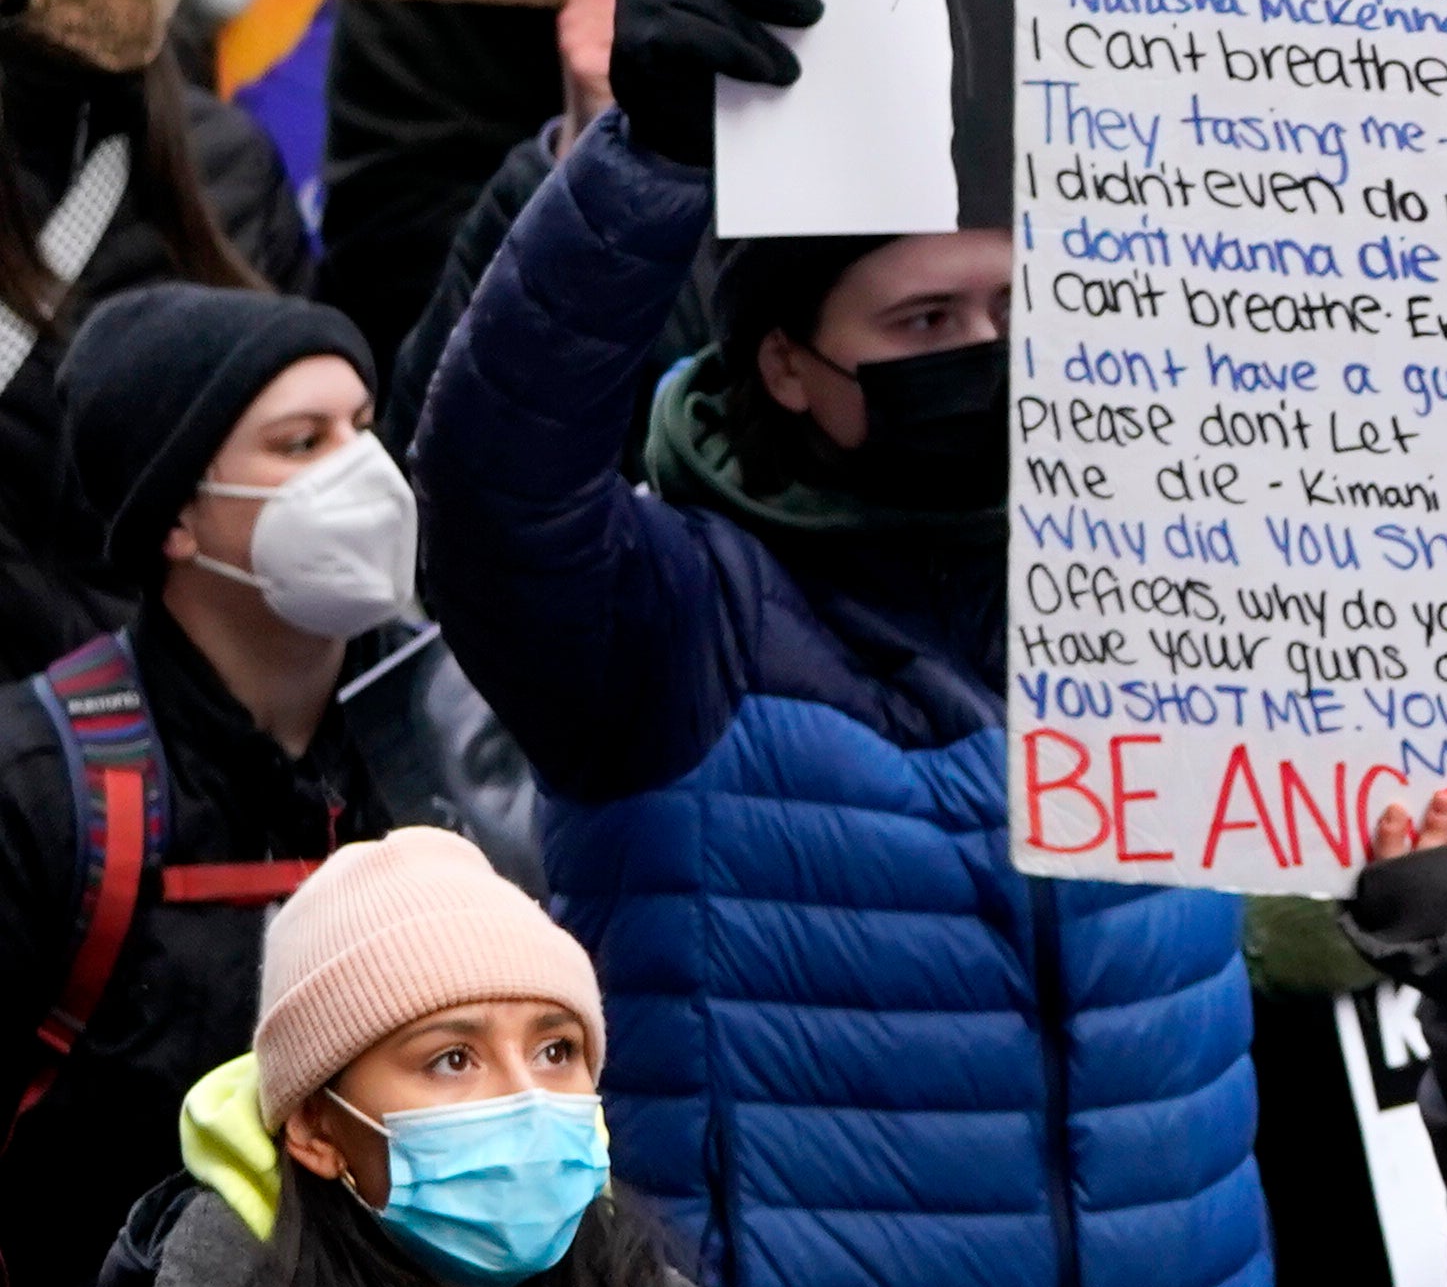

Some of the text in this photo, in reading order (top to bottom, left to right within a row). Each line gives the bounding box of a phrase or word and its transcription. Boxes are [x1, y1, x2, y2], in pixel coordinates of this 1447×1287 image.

[1022, 79, 1425, 193] They tasing me
[1019, 504, 1146, 568] Why
[1164, 513, 1240, 567] did
[1016, 671, 1113, 721] YOU
[1117, 680, 1248, 727] SHOT
[1018, 624, 1137, 667] Have
[1286, 643, 1408, 701] guns
[1022, 727, 1175, 864] BE
